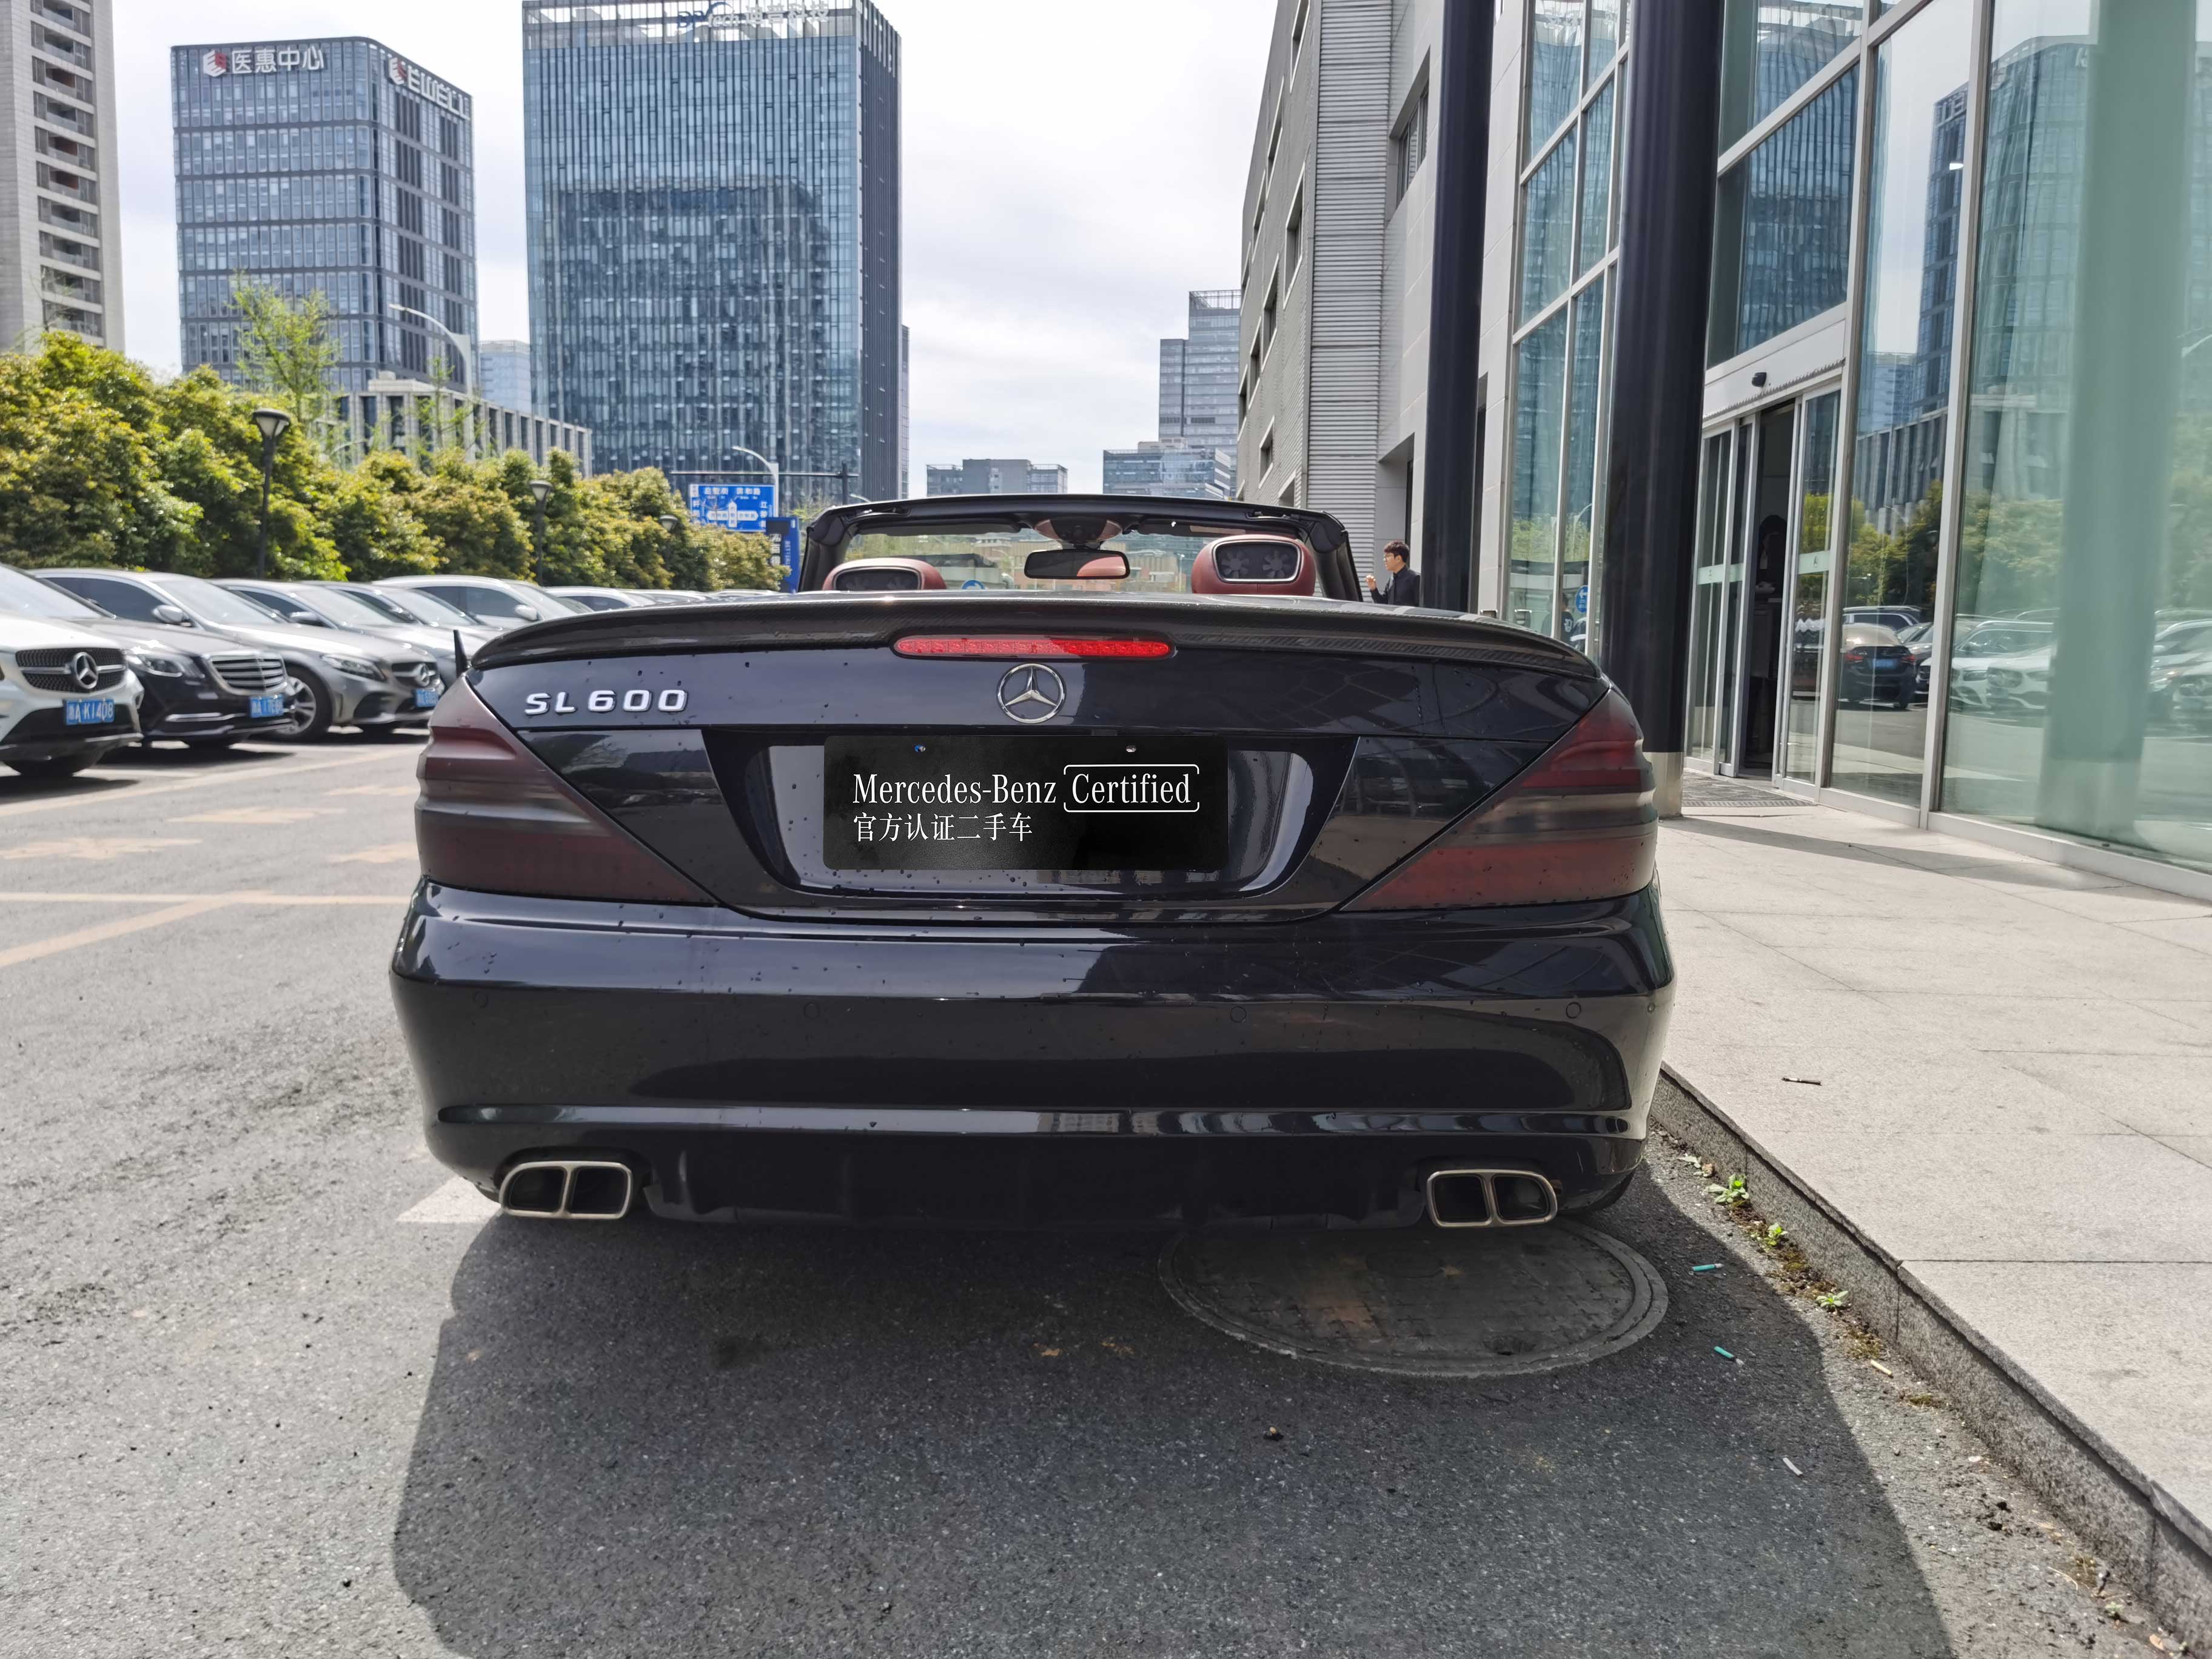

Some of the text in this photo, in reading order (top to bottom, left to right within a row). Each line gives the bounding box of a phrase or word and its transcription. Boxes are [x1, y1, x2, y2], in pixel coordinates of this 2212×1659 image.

[745, 3, 830, 24] 迪普科技
[232, 45, 324, 74] 医惠中心
[407, 64, 471, 121] EWELL
[587, 689, 688, 712] 600
[853, 773, 1191, 804] Mercedes-Benz Certified
[853, 812, 1033, 842] 官方认证二手车
